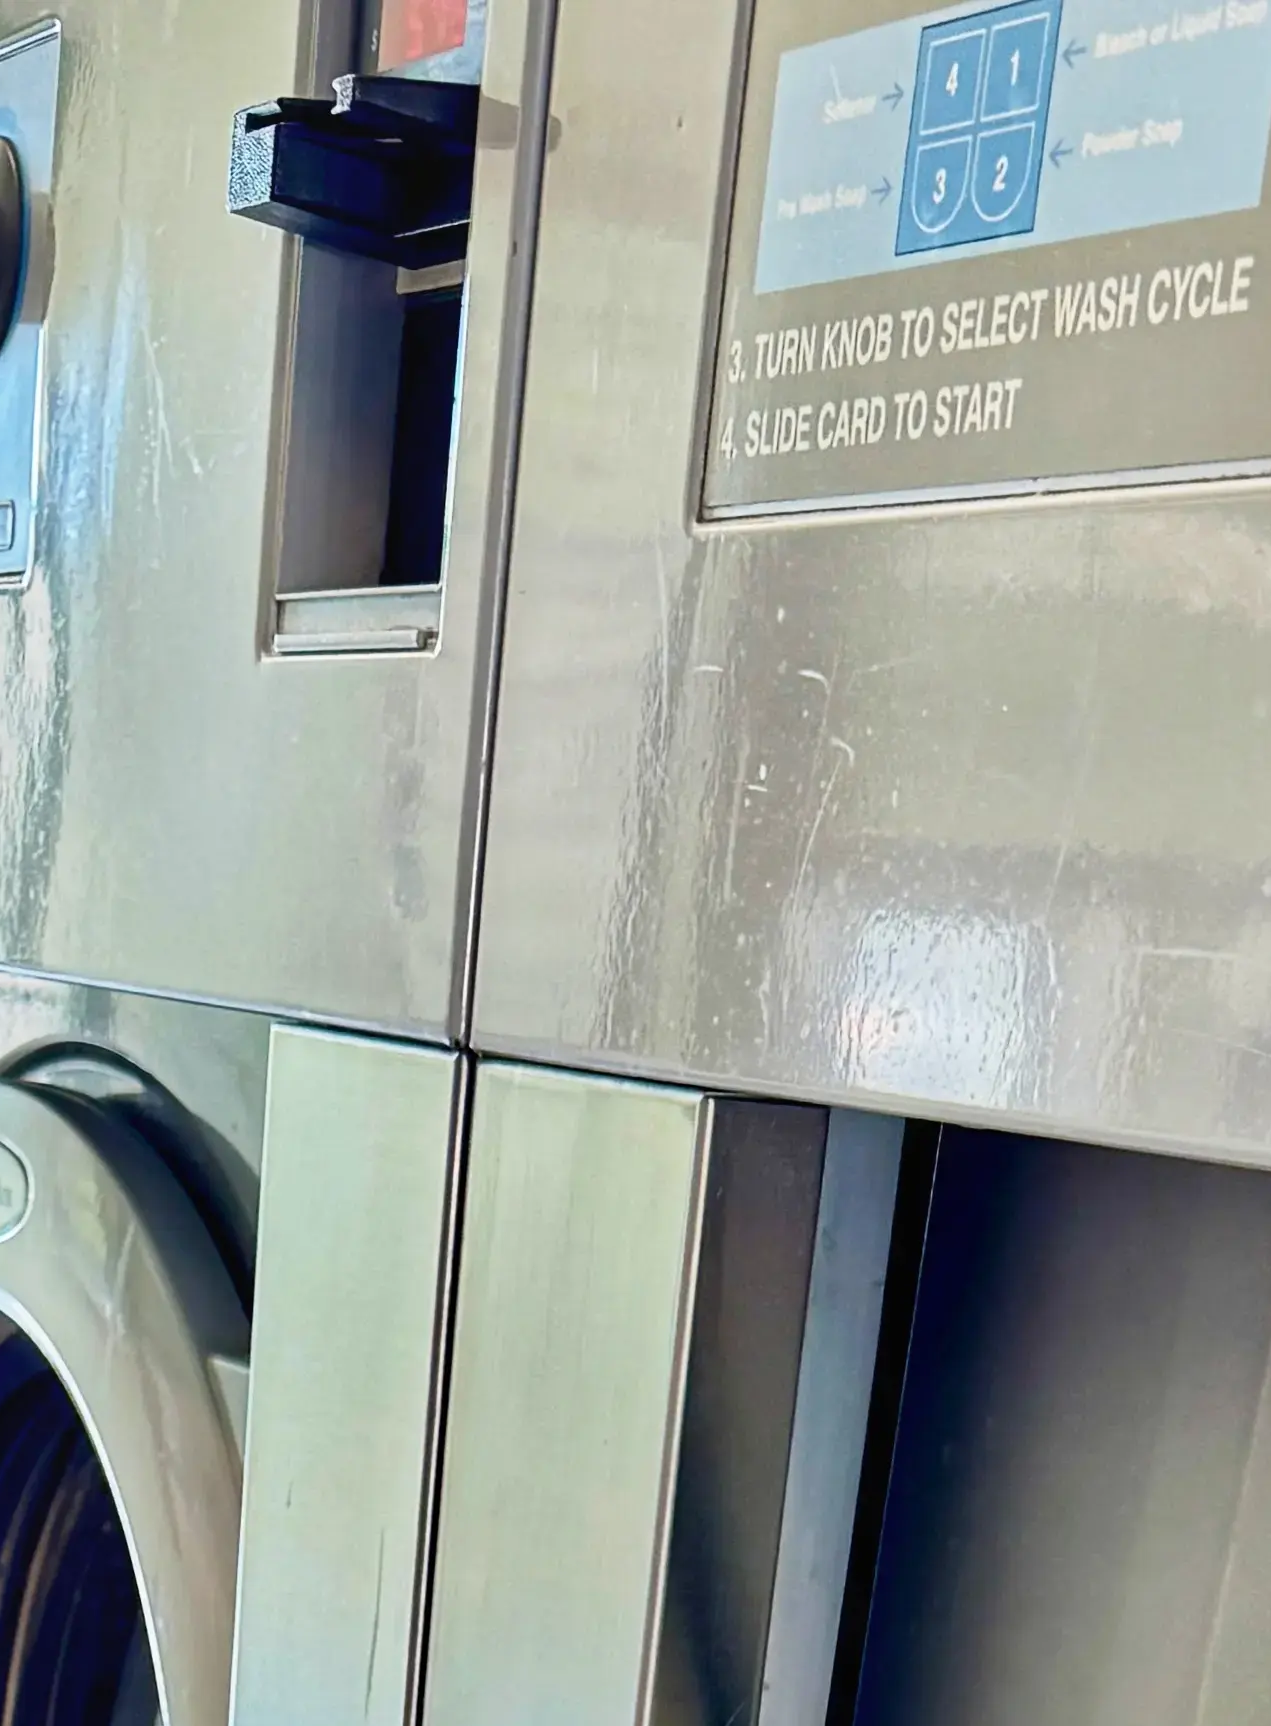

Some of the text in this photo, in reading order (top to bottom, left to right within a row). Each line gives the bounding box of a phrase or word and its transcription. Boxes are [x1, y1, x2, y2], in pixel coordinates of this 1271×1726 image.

[944, 48, 1021, 97] 4 1
[933, 155, 1009, 205] 3 2
[728, 256, 1254, 384] 3. TURN KNOB TO SELECT WASH CYCLE
[744, 404, 812, 458] SLIDE
[817, 395, 886, 450] CARD
[894, 389, 927, 441] TO
[933, 378, 1023, 437] START
